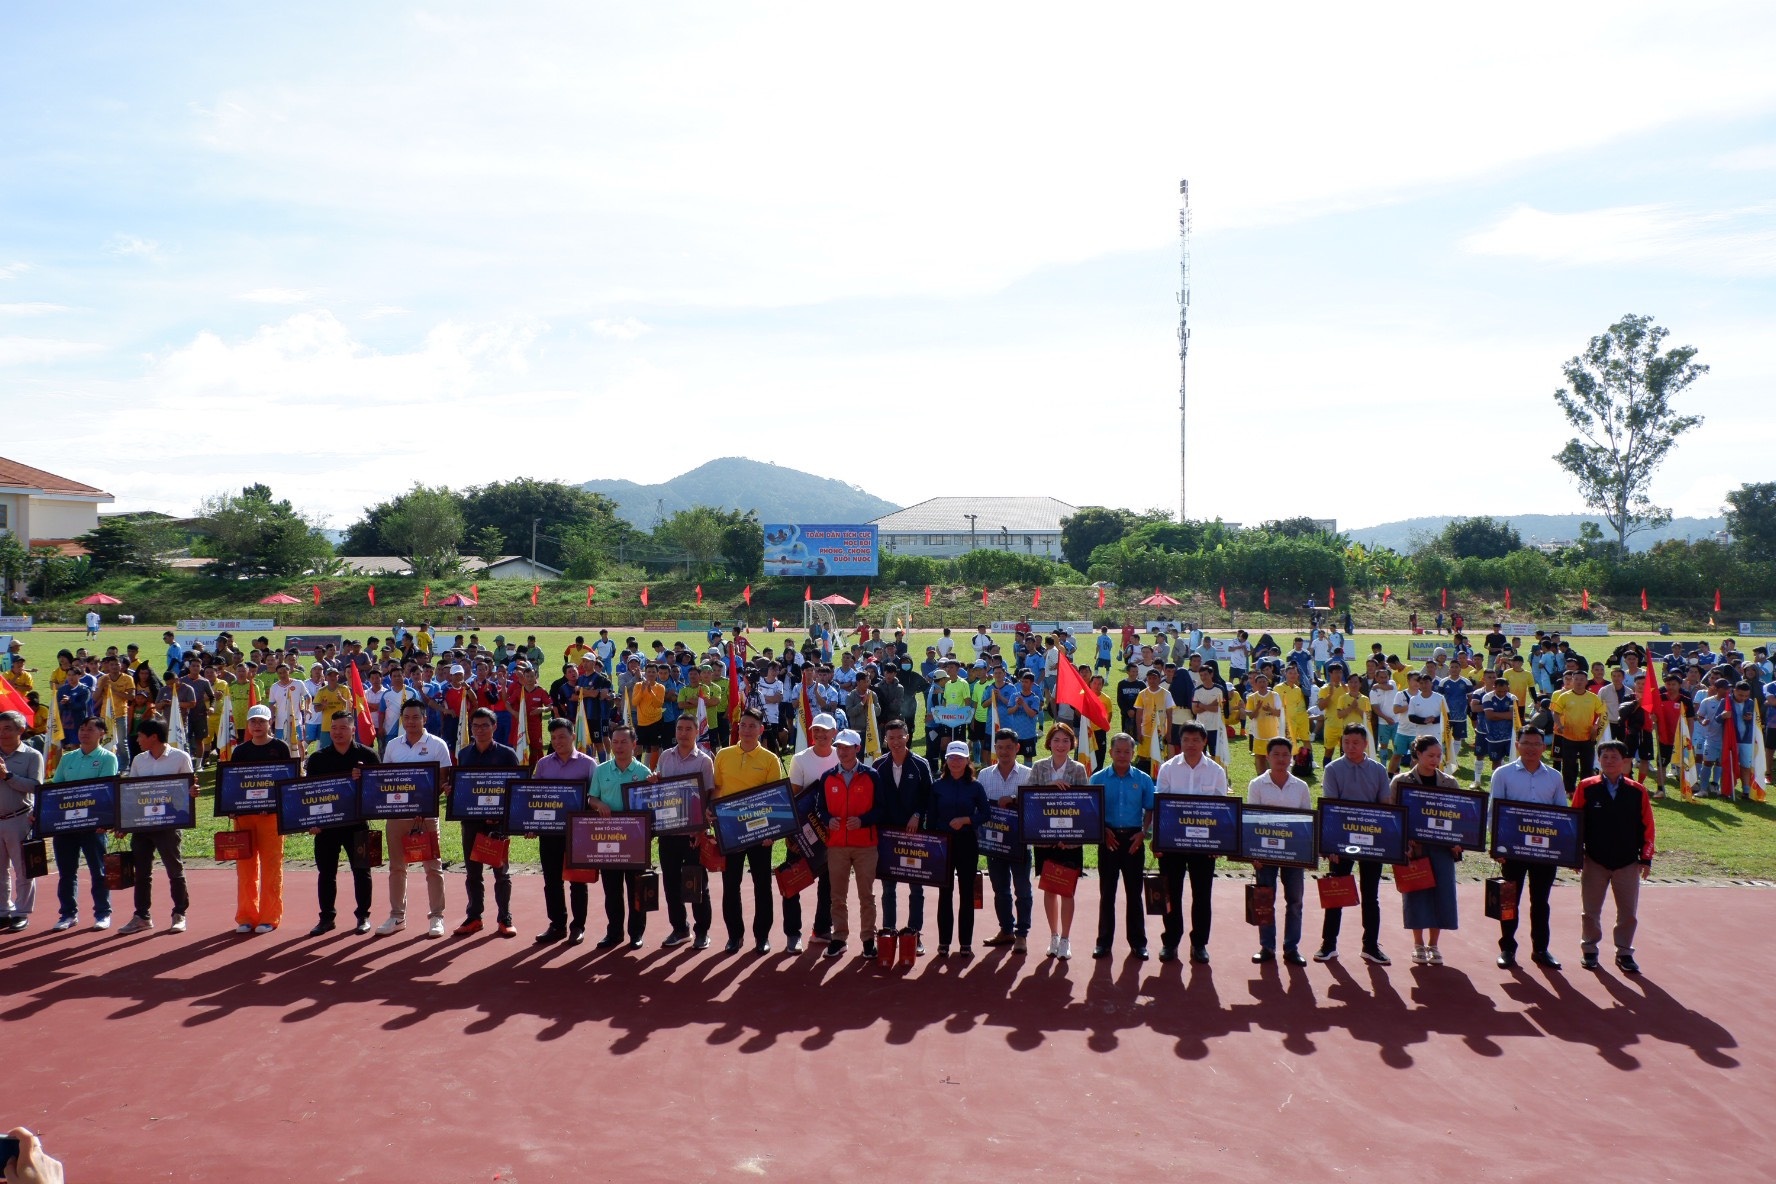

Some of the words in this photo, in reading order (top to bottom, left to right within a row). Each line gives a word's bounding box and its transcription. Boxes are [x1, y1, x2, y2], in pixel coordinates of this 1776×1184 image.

[397, 783, 416, 792] NIỆM
[302, 796, 318, 804] LƯU
[319, 793, 339, 804] NIỆM
[544, 800, 564, 809] NIỆM
[736, 811, 752, 822] LƯU
[752, 806, 772, 818] NIỆM
[1060, 808, 1080, 816] NIỆM
[1422, 807, 1438, 816] LƯU
[1440, 808, 1461, 820] NIỆM
[1179, 816, 1194, 824] LƯU
[1196, 817, 1216, 826] NIỆM
[1254, 827, 1270, 836] LƯU
[1272, 828, 1292, 838] NIỆM
[1343, 822, 1359, 830] LƯU
[1361, 823, 1382, 834] NIỆM
[1519, 824, 1536, 832] LƯU
[1536, 825, 1558, 836] NIỆM
[608, 832, 626, 841] NIỆM
